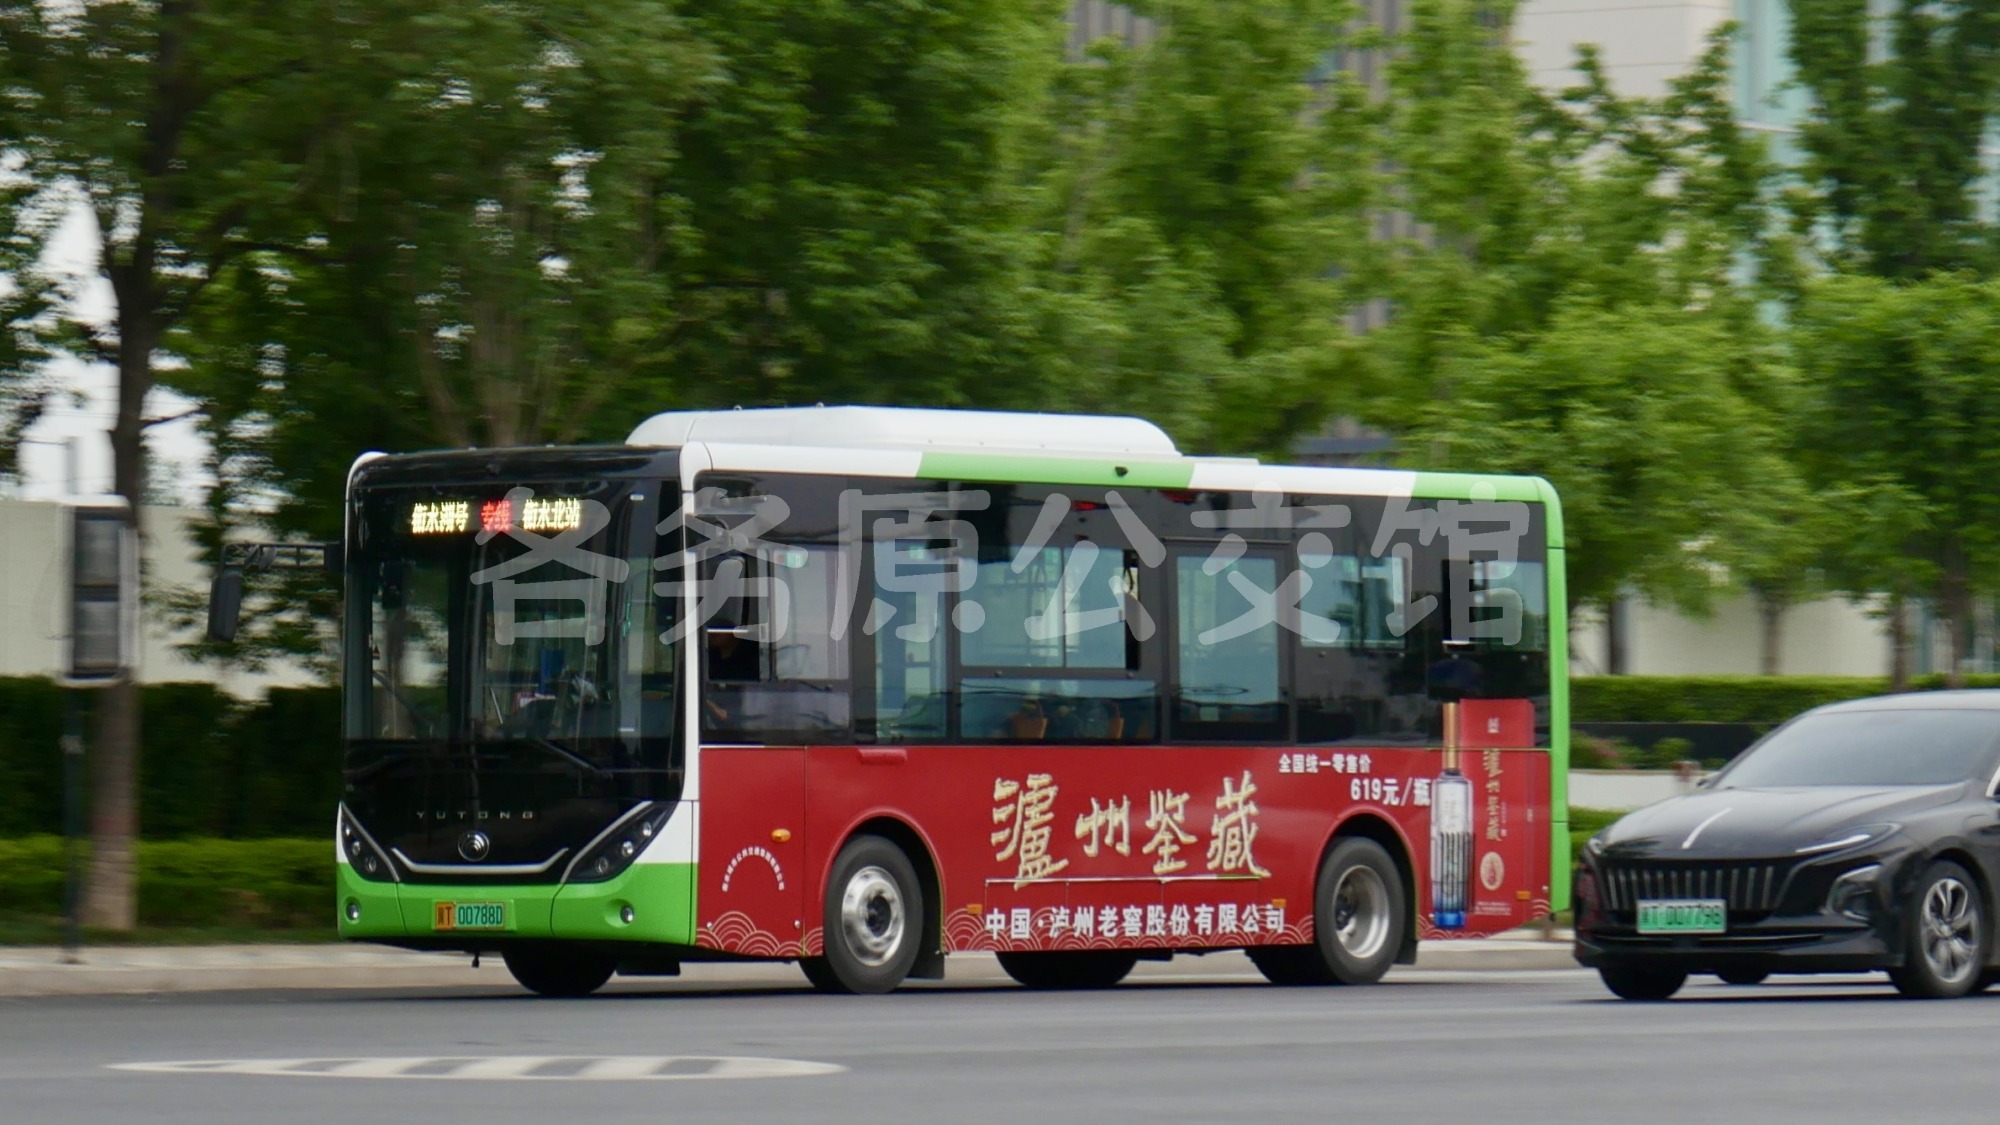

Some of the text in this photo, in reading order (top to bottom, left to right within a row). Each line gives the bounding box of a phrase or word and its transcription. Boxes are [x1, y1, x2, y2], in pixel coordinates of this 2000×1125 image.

[481, 500, 511, 531] 专线
[523, 498, 580, 530] 衡水北站
[1279, 754, 1372, 774] 全国统一零售价
[1350, 777, 1432, 806] 619元/瓶
[416, 811, 534, 820] YUTONG
[458, 905, 503, 925] 00788D
